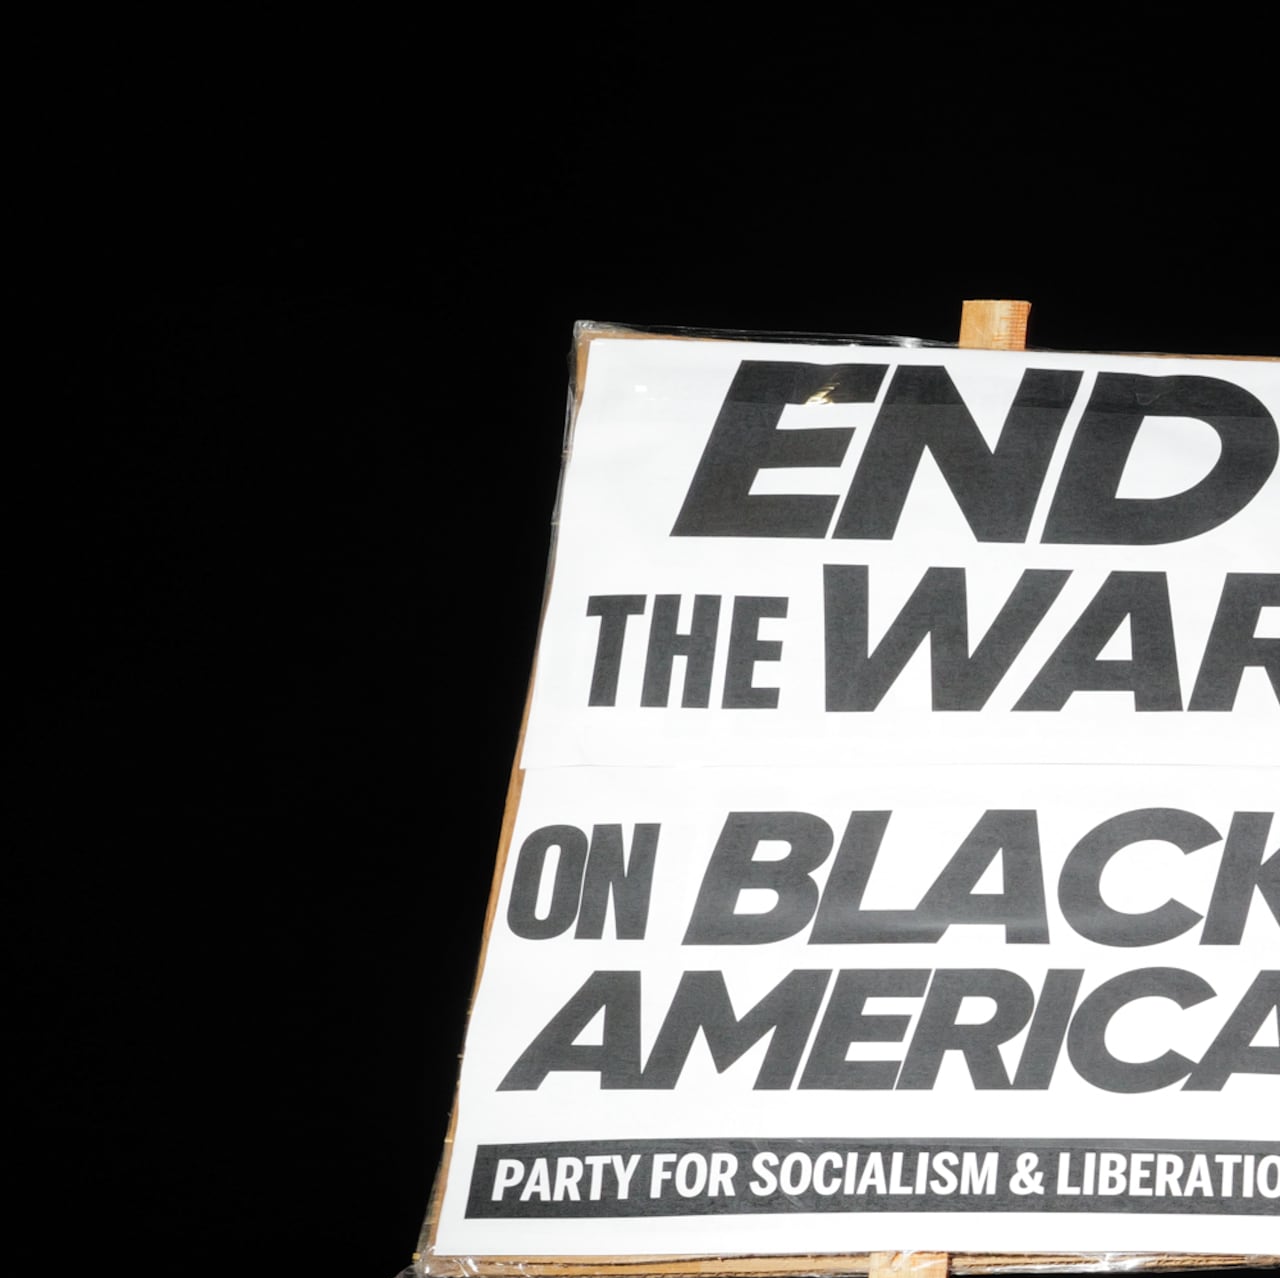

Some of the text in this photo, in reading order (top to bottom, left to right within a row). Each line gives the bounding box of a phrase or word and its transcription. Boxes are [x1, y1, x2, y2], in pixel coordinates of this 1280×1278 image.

[670, 360, 1279, 545] END
[587, 595, 788, 708] THE
[508, 824, 660, 939] ON
[492, 1154, 641, 1201] PARTY
[650, 1152, 738, 1198] FOR
[749, 1151, 999, 1196] SOCIALISM
[1009, 1152, 1045, 1195] &
